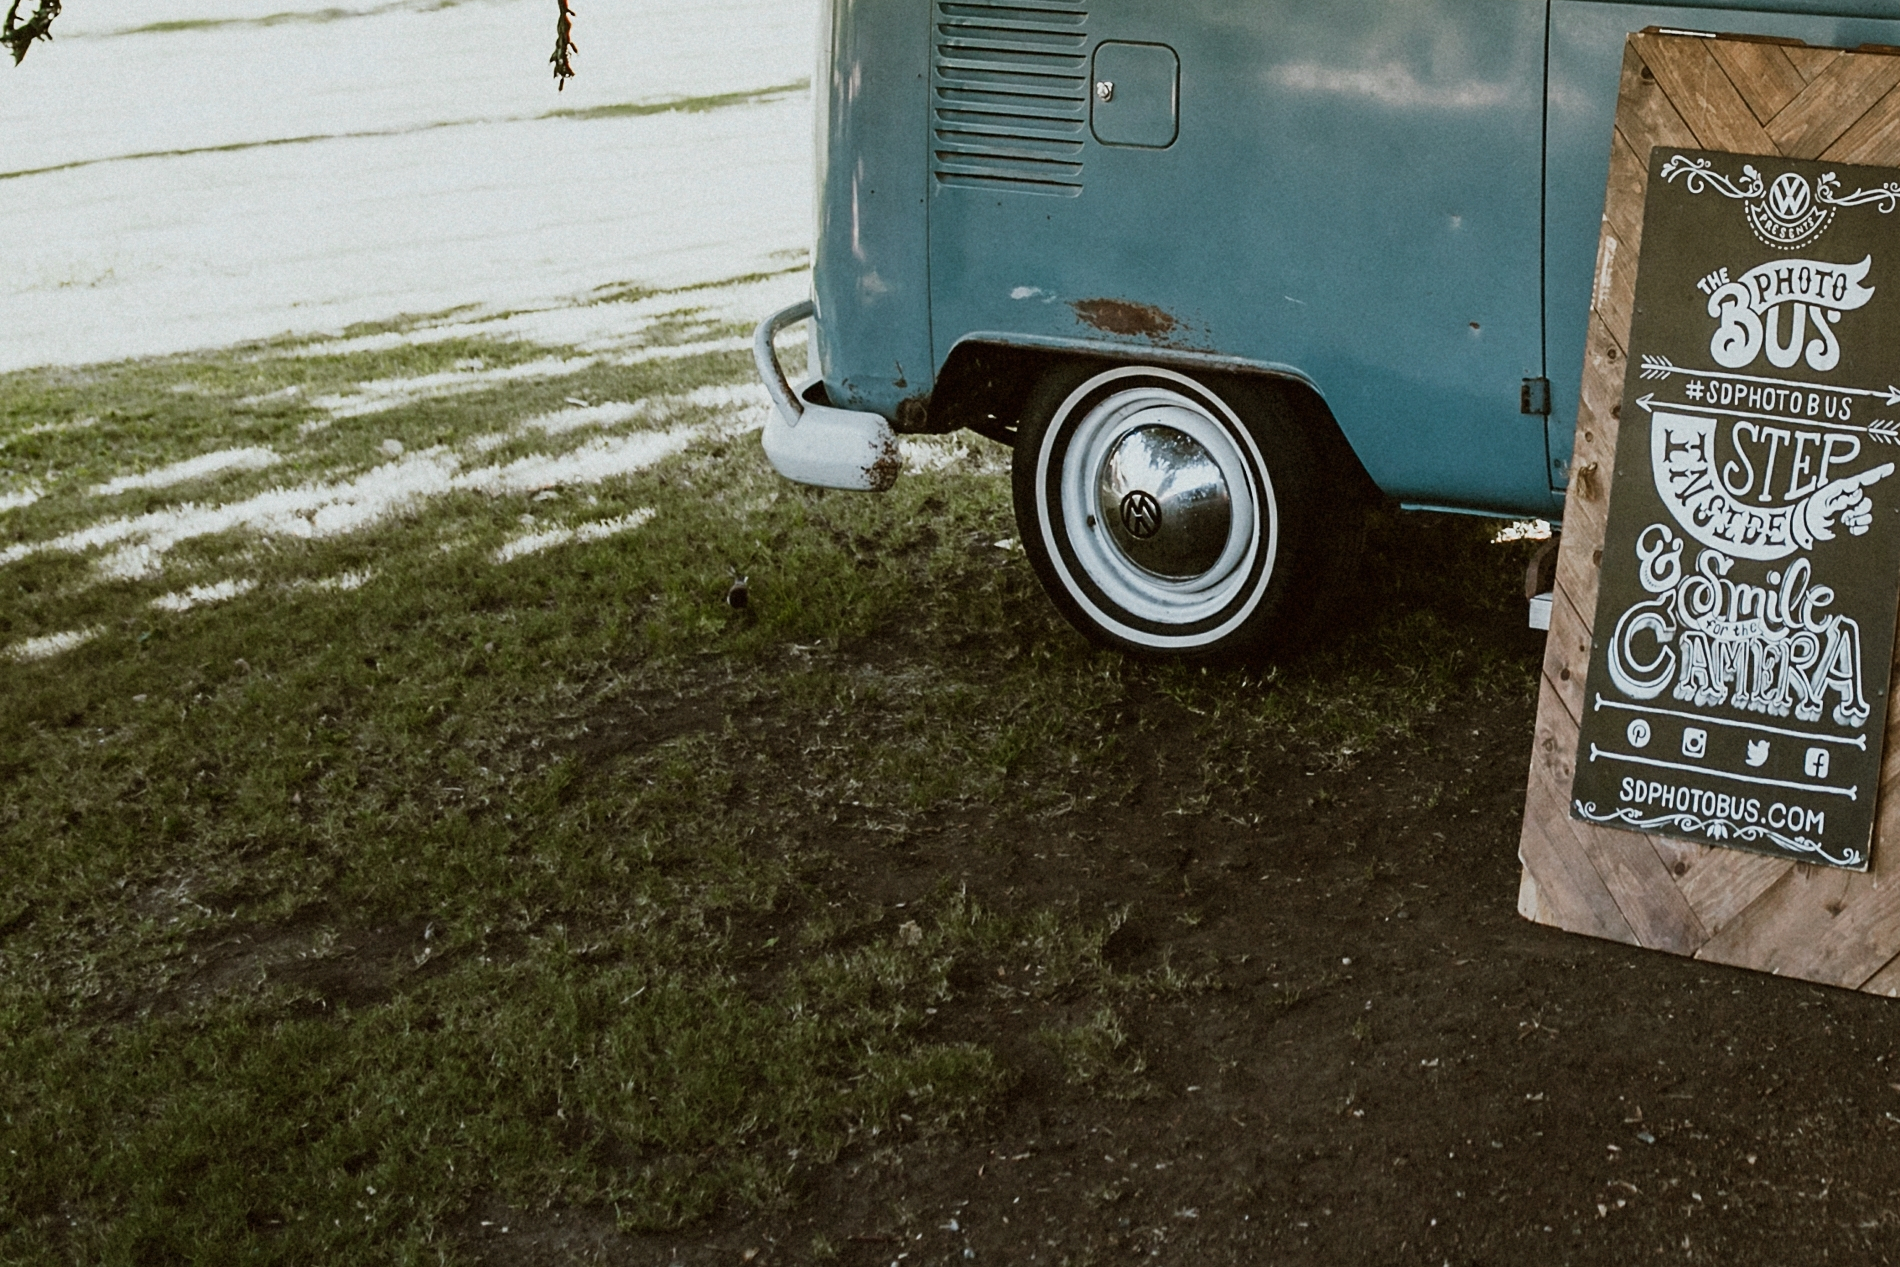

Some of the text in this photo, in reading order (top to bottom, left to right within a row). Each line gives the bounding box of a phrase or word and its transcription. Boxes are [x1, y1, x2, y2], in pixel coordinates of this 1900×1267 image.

[1759, 213, 1815, 239] PRESENTS
[1697, 266, 1730, 295] THE
[1753, 266, 1848, 305] PHOTO
[1707, 282, 1841, 372] BUS
[1685, 379, 1853, 421] #SDPHOTOBUS
[1663, 428, 1787, 547] INSIDE
[1723, 420, 1861, 502] STEP
[1636, 523, 1684, 593] &
[1676, 548, 1835, 643] Smile
[1705, 619, 1758, 636] for the
[1608, 589, 1871, 728] CAMERA
[1620, 777, 1825, 835] SDPHOTOBUS.COM
